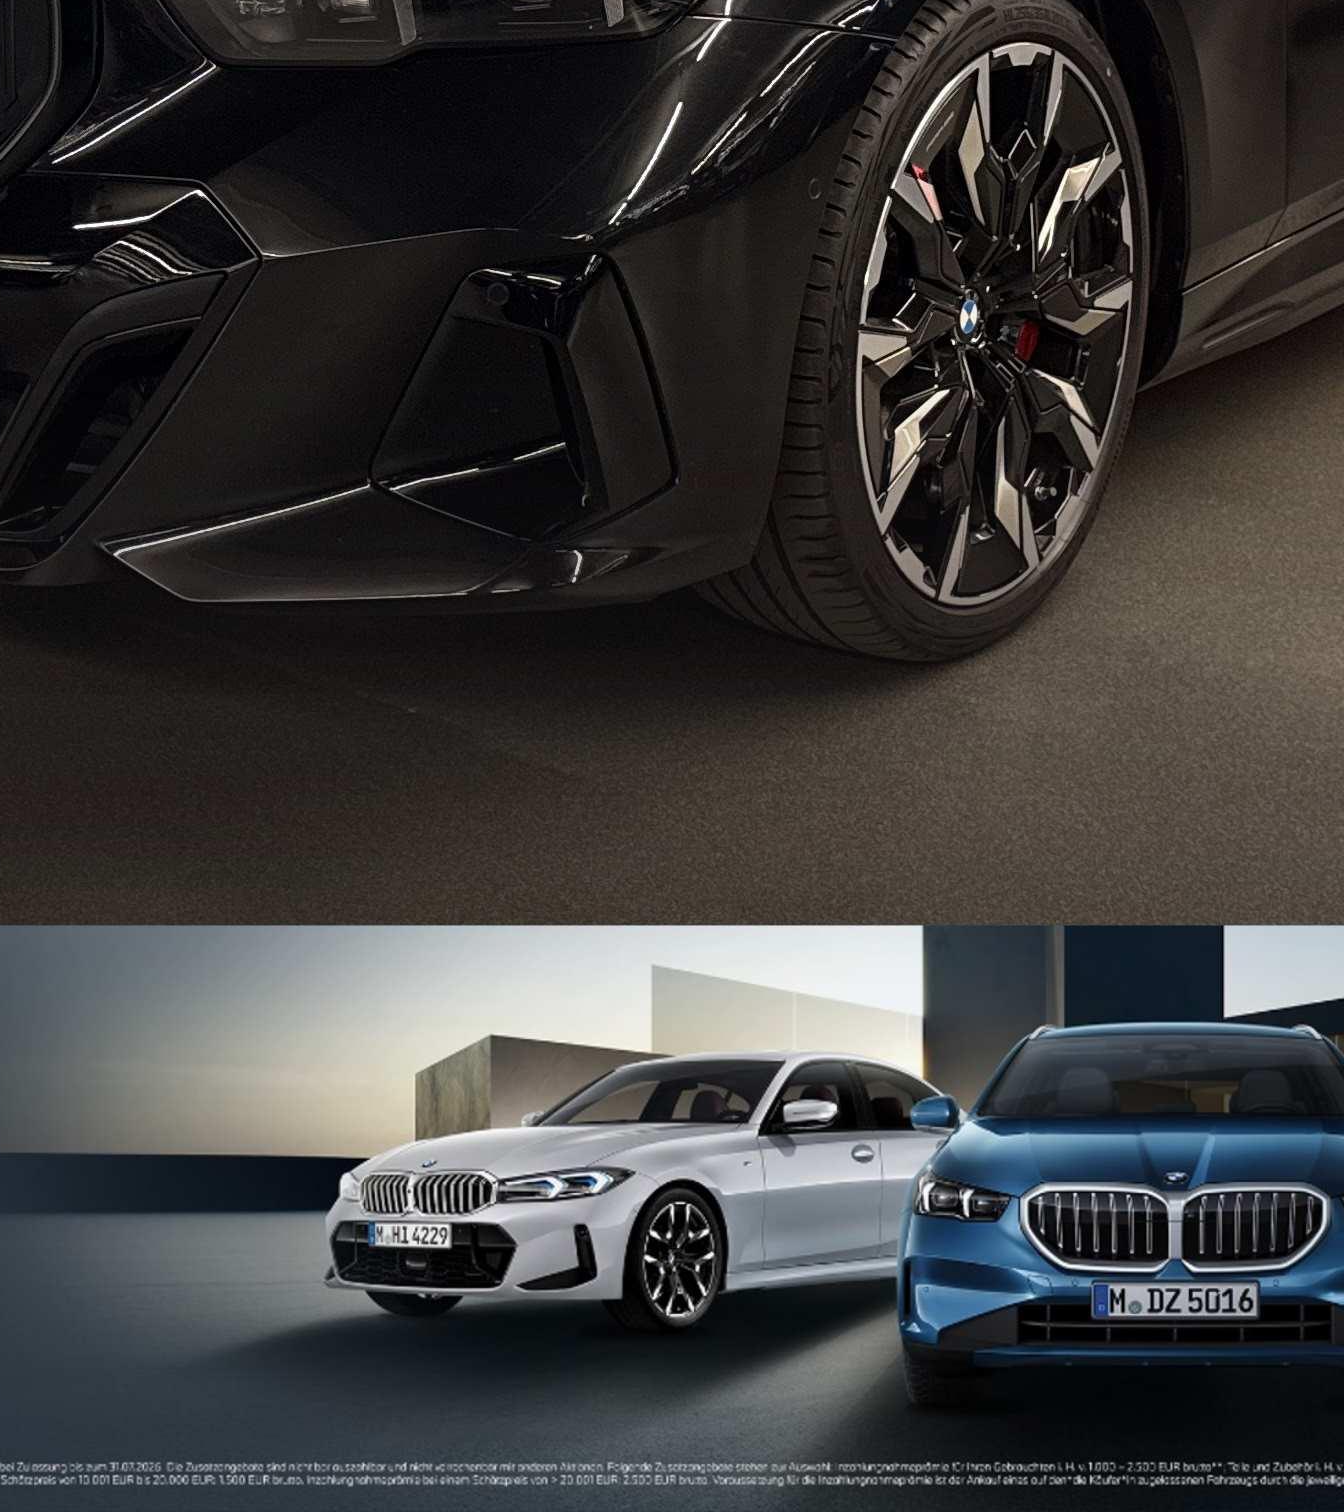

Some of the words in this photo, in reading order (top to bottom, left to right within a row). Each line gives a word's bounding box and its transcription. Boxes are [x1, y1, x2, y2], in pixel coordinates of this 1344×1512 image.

[412, 1226, 448, 1245] 4229
[1109, 1288, 1126, 1314] M
[1147, 1288, 1181, 1314] DZ
[1188, 1288, 1254, 1314] 5016
